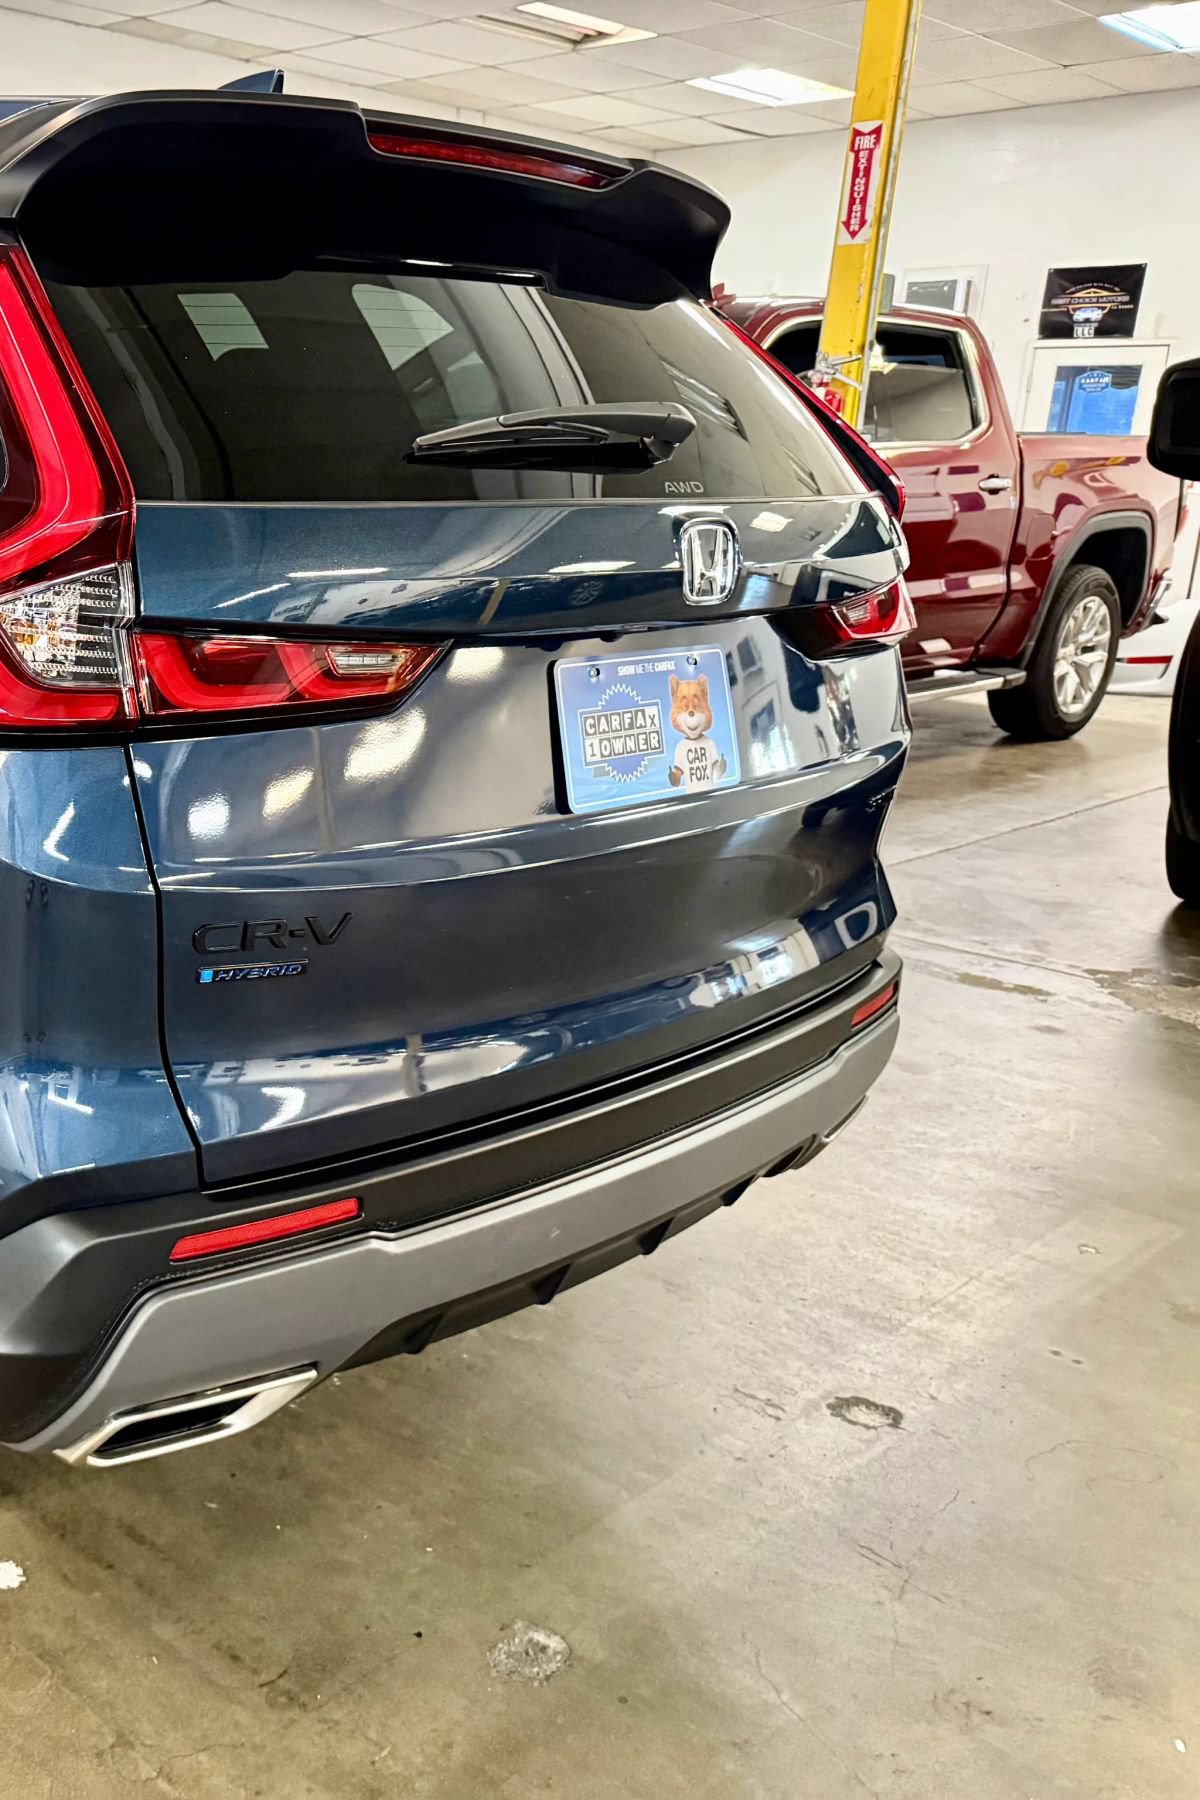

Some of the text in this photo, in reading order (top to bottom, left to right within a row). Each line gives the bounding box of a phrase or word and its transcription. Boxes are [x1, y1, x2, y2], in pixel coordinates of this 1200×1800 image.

[854, 135, 877, 151] FIRE
[849, 151, 869, 232] EXTINGUISHER
[664, 481, 704, 494] AWD
[585, 709, 658, 734] CARFAX
[601, 734, 659, 756] OWNER
[686, 746, 707, 764] CAR
[192, 912, 352, 953] CR-V
[215, 964, 303, 981] HYBRID
